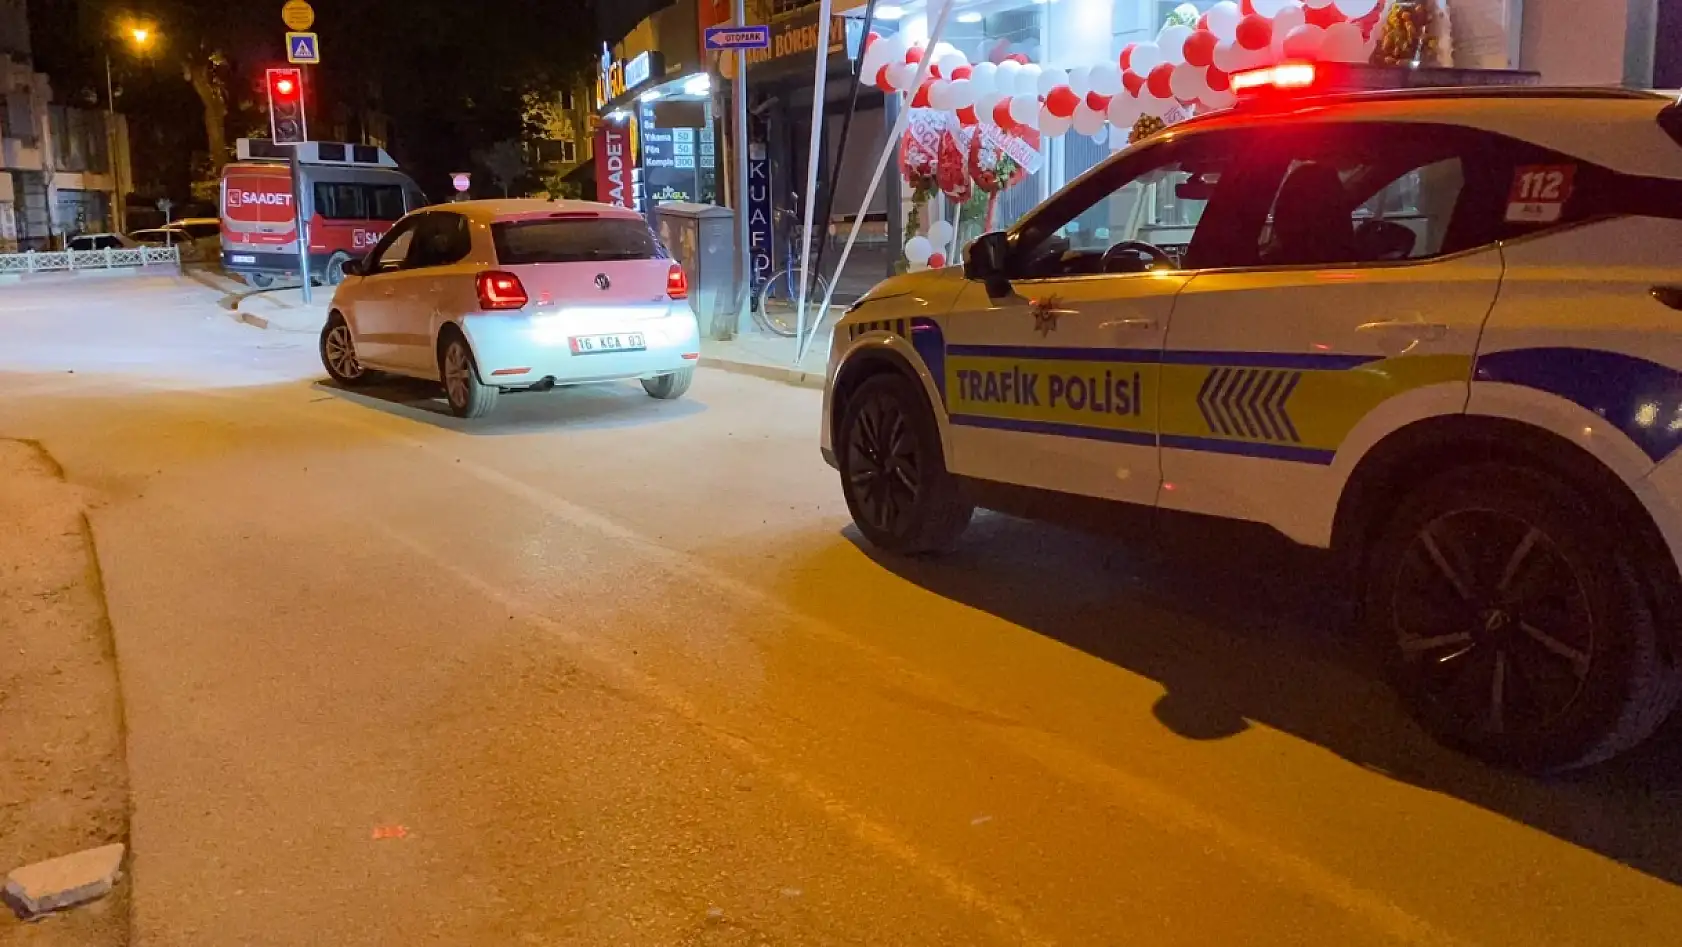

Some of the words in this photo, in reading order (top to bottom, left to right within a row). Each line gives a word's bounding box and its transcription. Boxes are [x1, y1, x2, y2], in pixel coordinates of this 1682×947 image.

[724, 32, 761, 42] OTOPARK
[677, 132, 689, 140] 50
[677, 145, 689, 153] 50
[676, 158, 693, 166] 300
[1520, 171, 1564, 199] 112
[242, 191, 293, 207] SAADET
[579, 338, 593, 350] 16
[600, 336, 621, 349] KCA
[956, 365, 1040, 406] TRAFİK
[1049, 370, 1141, 416] POLİSİ
